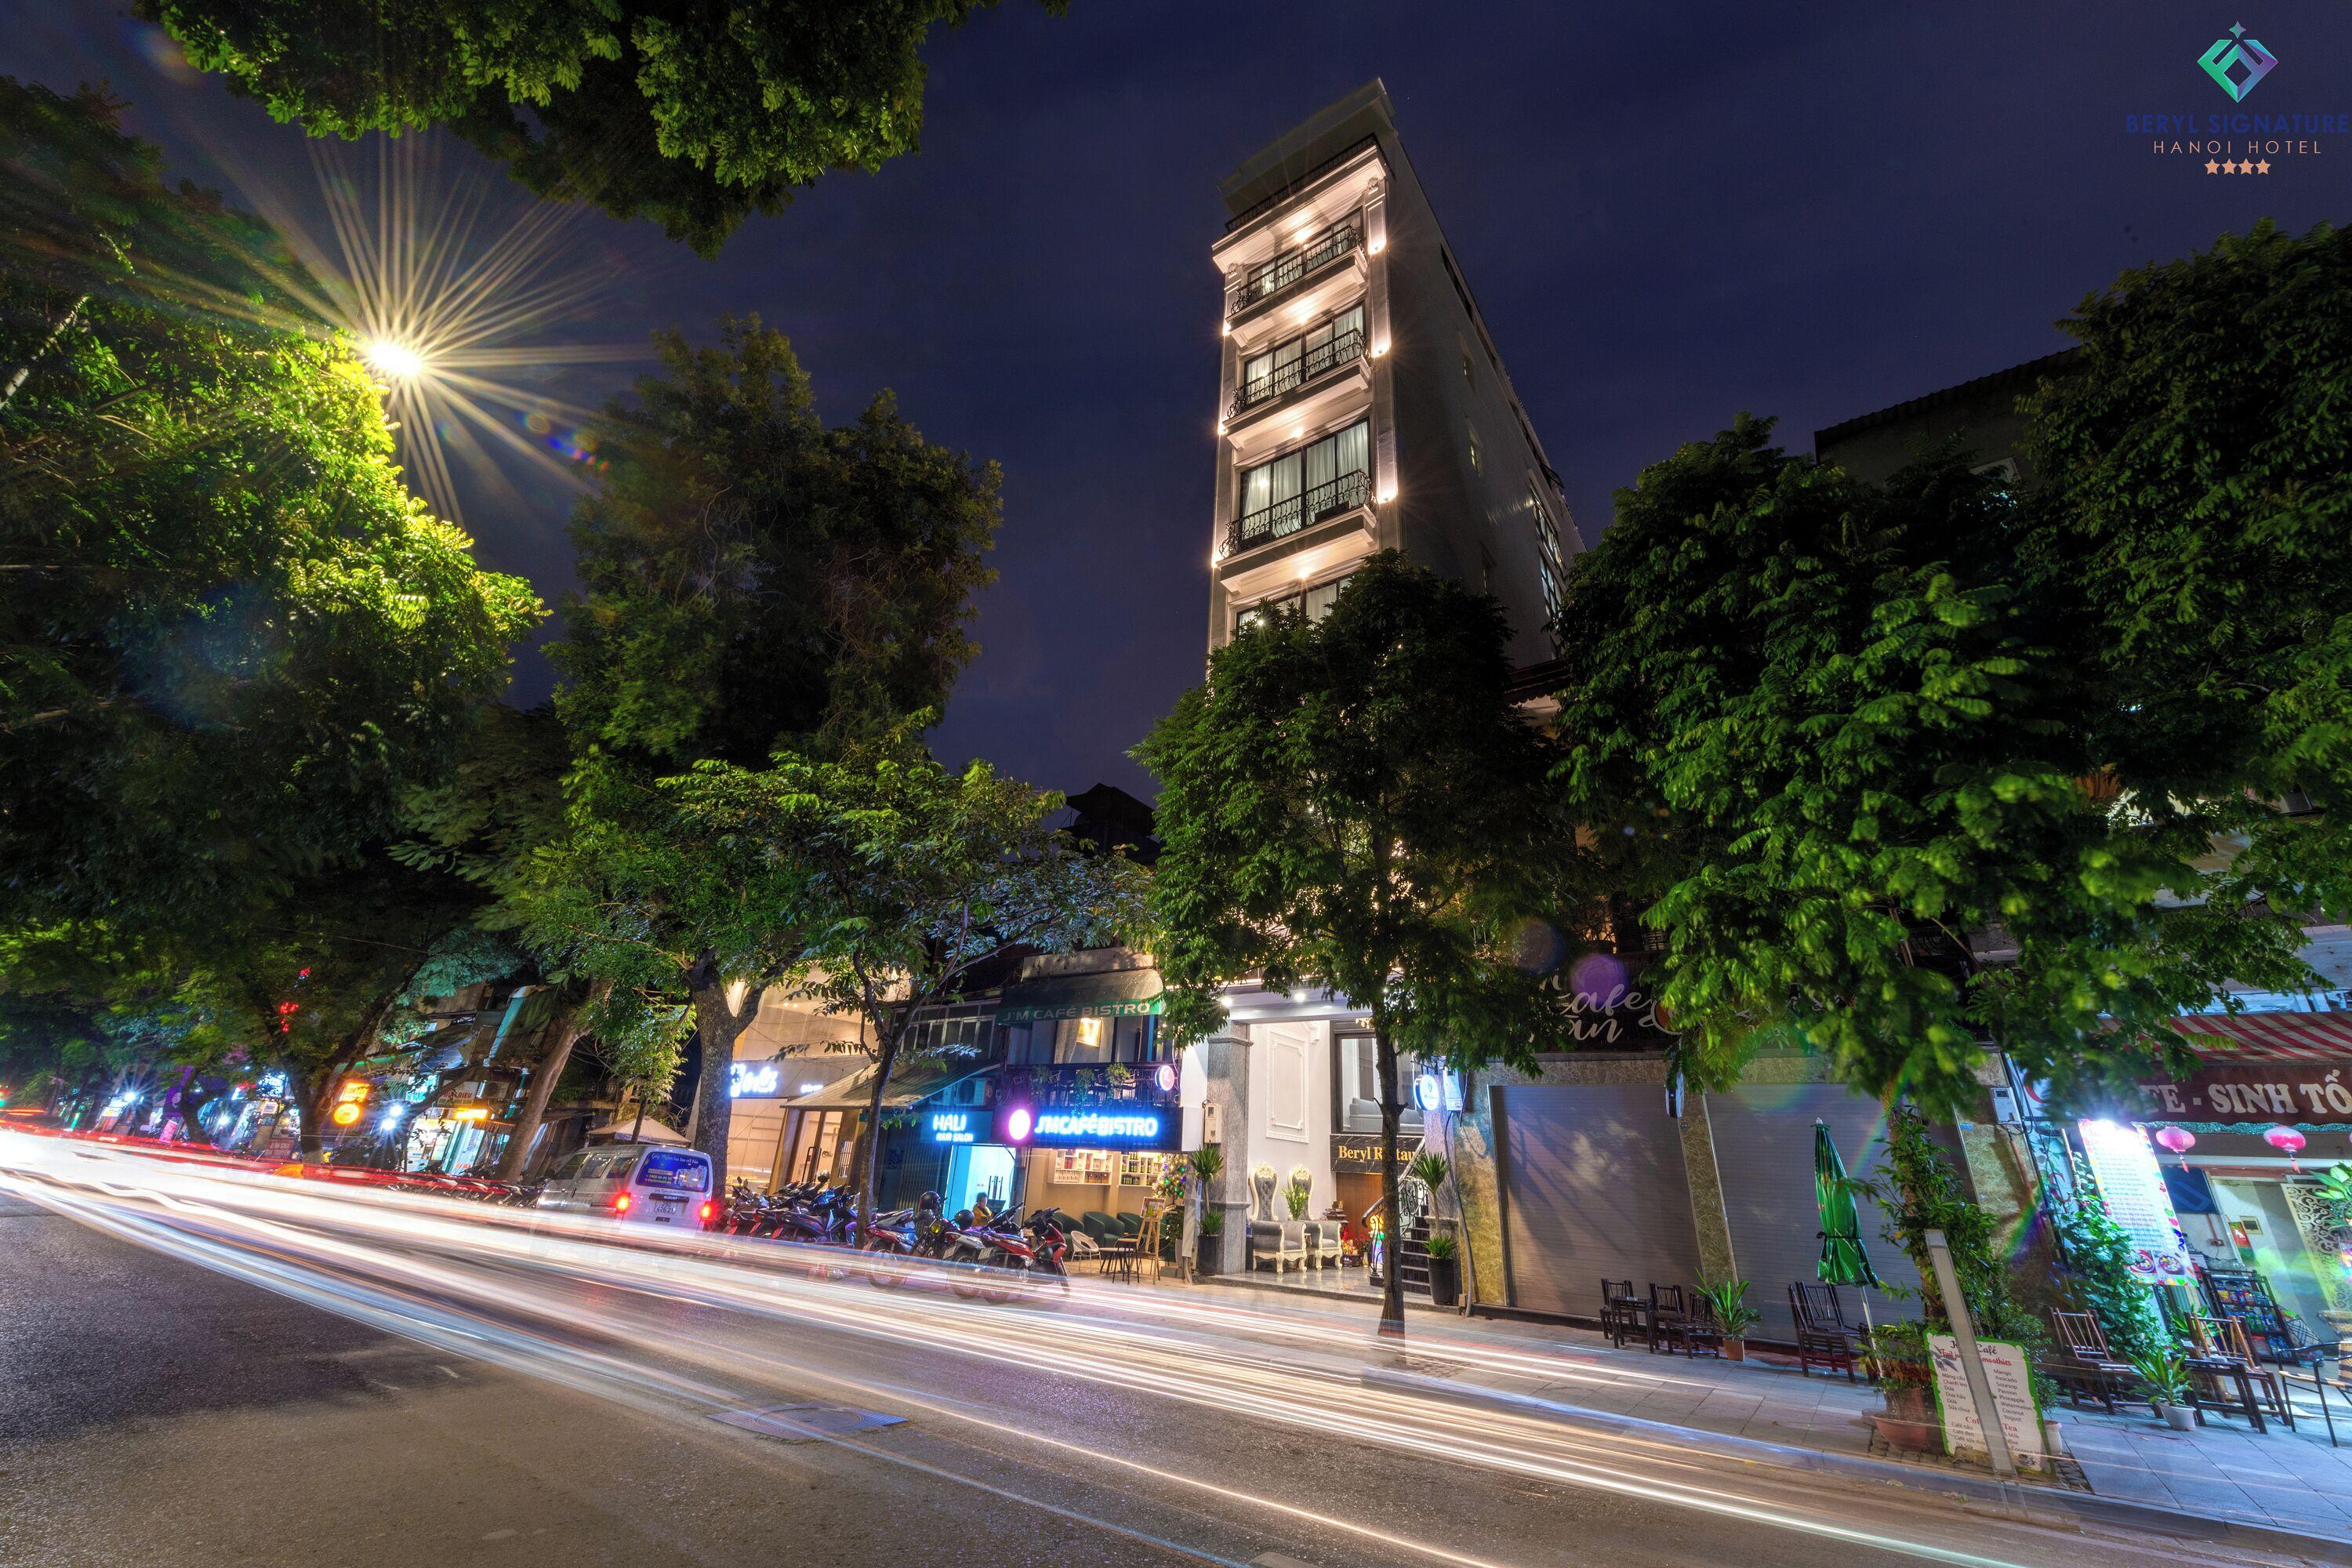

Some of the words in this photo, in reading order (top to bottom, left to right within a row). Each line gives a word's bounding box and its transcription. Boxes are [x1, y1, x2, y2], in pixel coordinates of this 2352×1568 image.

[1033, 1005, 1076, 1019] CAFÉ
[1081, 1003, 1151, 1018] BISTRO
[2208, 1083, 2299, 1114] SINH
[933, 1114, 967, 1131] HALI
[1097, 1116, 1158, 1137] BISTRO
[936, 1132, 952, 1141] HAIR
[953, 1133, 974, 1142] SALON
[1338, 1145, 1371, 1163] Beryl
[1981, 1357, 2013, 1367] moothies
[1996, 1381, 2018, 1390] Soursop
[1999, 1395, 2024, 1403] Pineapple
[2001, 1401, 2033, 1411] Watermelon
[2002, 1408, 2024, 1417] Coconut
[2003, 1423, 2018, 1432] Tea
